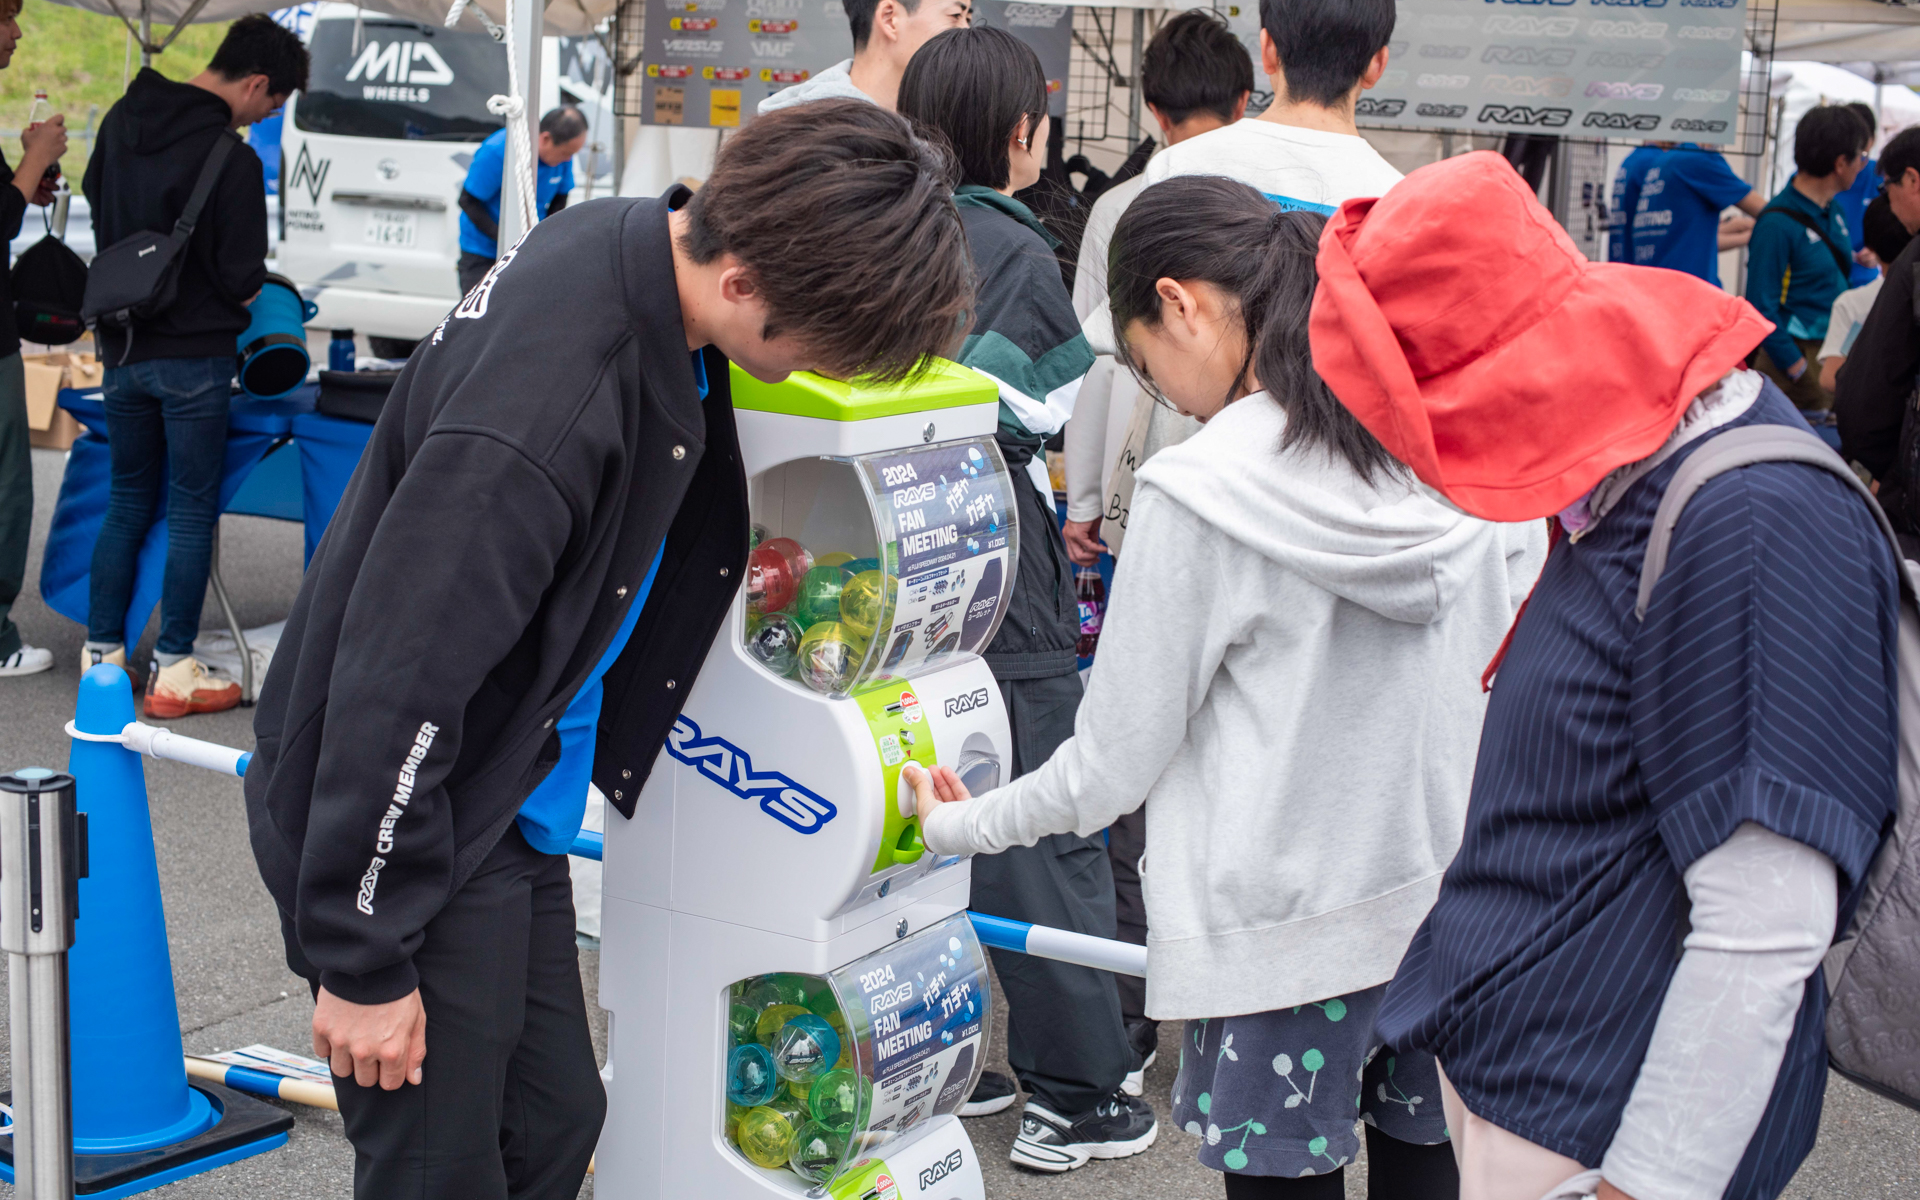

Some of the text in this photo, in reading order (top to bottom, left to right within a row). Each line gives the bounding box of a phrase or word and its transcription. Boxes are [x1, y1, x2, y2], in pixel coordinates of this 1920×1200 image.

[1481, 14, 1579, 37] RAYS
[1588, 19, 1668, 39] RAYS
[1481, 45, 1576, 66] RAYS
[363, 86, 430, 103] WHEELS
[1481, 74, 1574, 97] RAYS
[1583, 81, 1664, 101] RAYS
[1355, 98, 1407, 117] AYS
[1478, 105, 1572, 127] RAYS
[1582, 112, 1661, 132] RAYS
[1671, 118, 1728, 133] RAYS
[286, 221, 325, 232] POWER
[882, 463, 918, 487] 2024
[893, 481, 936, 509] RAYS
[945, 477, 995, 527] ガチャ ガチャ
[898, 508, 926, 533] FAN
[902, 524, 958, 558] MEETING
[988, 537, 1006, 549] ¥1,000
[969, 596, 997, 613] RAYS
[944, 688, 988, 718] RAYS
[663, 713, 838, 835] RAYS
[357, 721, 440, 915] RAYS CREW MEMBER
[859, 964, 895, 993] 2024
[871, 981, 913, 1015] RAYS
[922, 971, 971, 1019] ガチャ ガチャ
[874, 1011, 900, 1039] FAN
[877, 1020, 932, 1061] MEETING
[919, 1149, 962, 1191] RAYS
